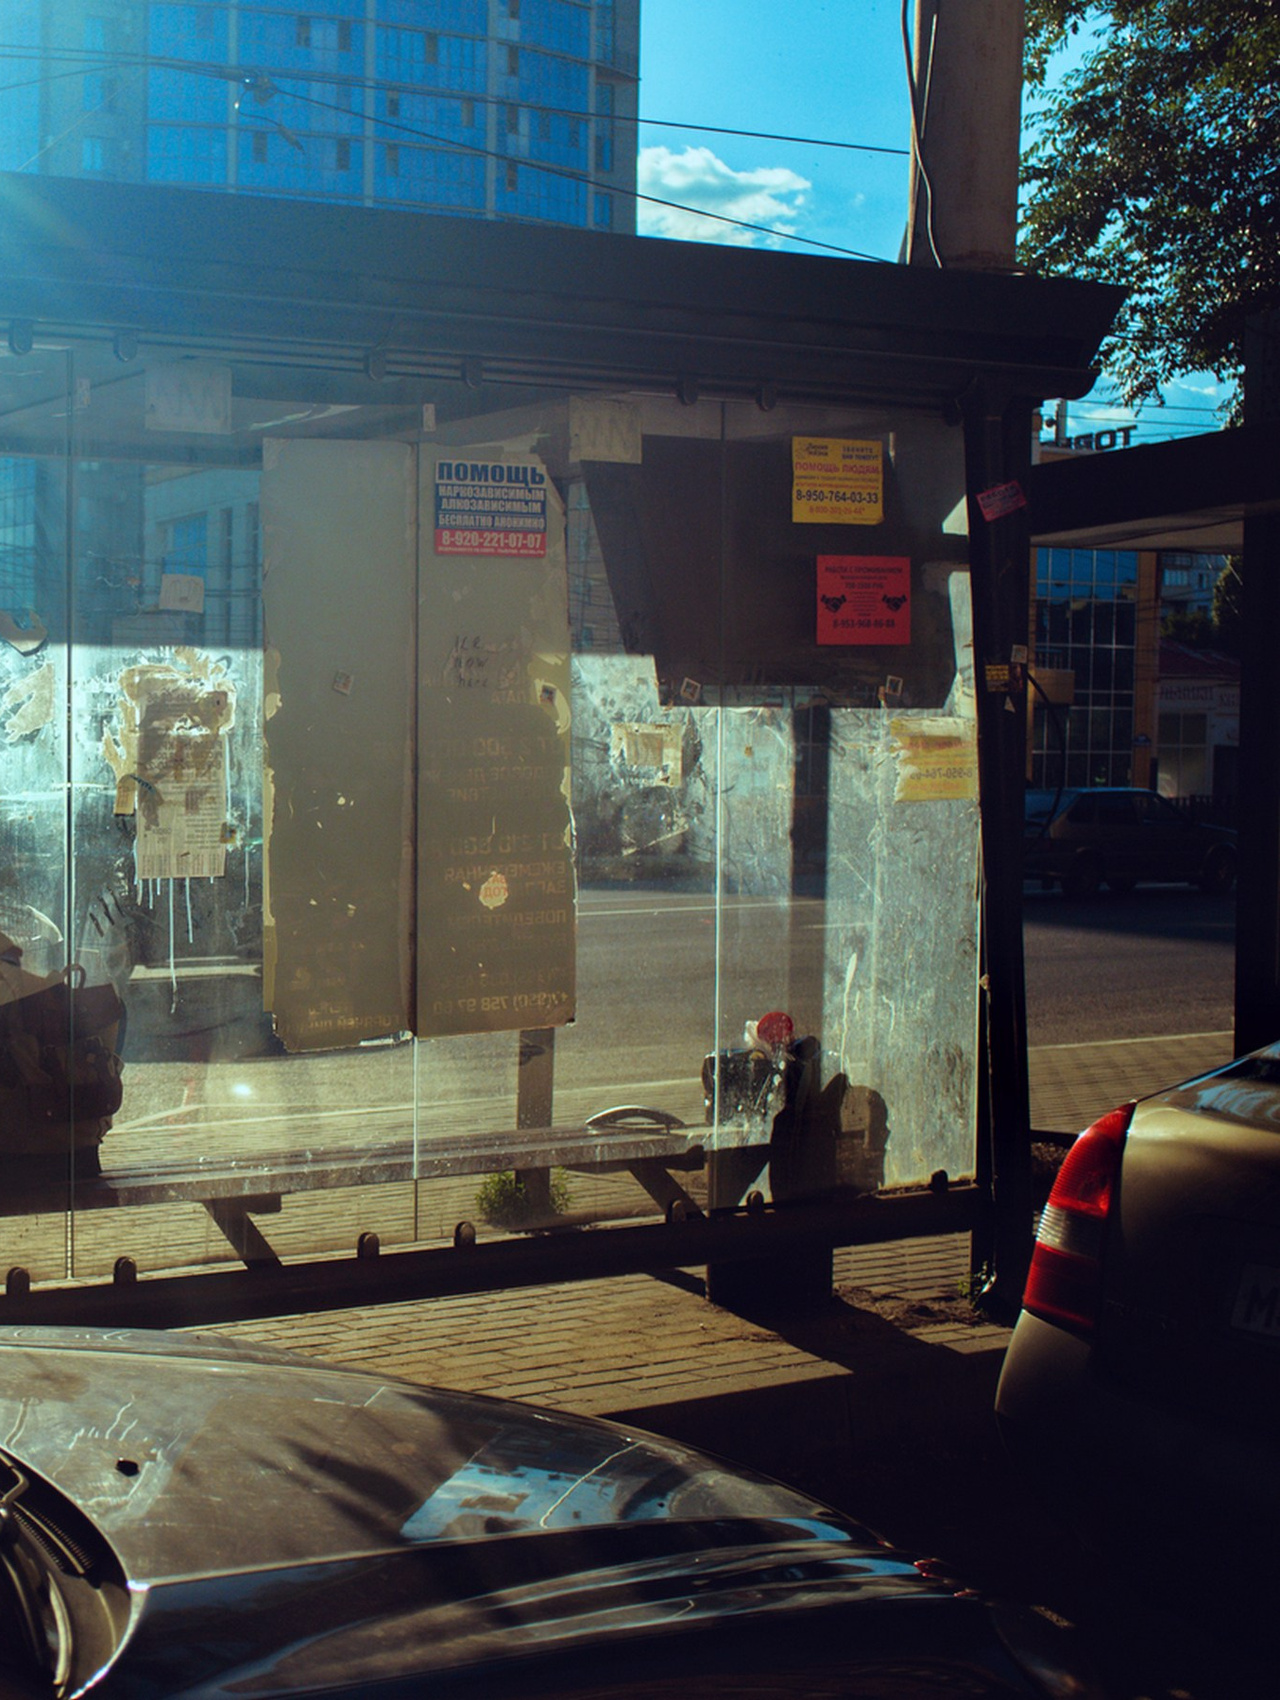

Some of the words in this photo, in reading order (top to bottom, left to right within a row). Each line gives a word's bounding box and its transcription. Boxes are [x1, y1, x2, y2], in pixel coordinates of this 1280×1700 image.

[438, 462, 546, 487] ПОМОЩЬ
[795, 461, 840, 473] ПОМОЩЬ
[438, 485, 545, 501] НАРКОЗАВИСИМЫМ
[795, 489, 879, 504] 8-950-764-03-33
[441, 498, 542, 513] АЛКОЗАВИСИМЫМ
[438, 514, 493, 528] БЕСПЛАТНО
[494, 516, 545, 530] АНОНИМНО
[441, 531, 542, 548] 8-920-221-07-07
